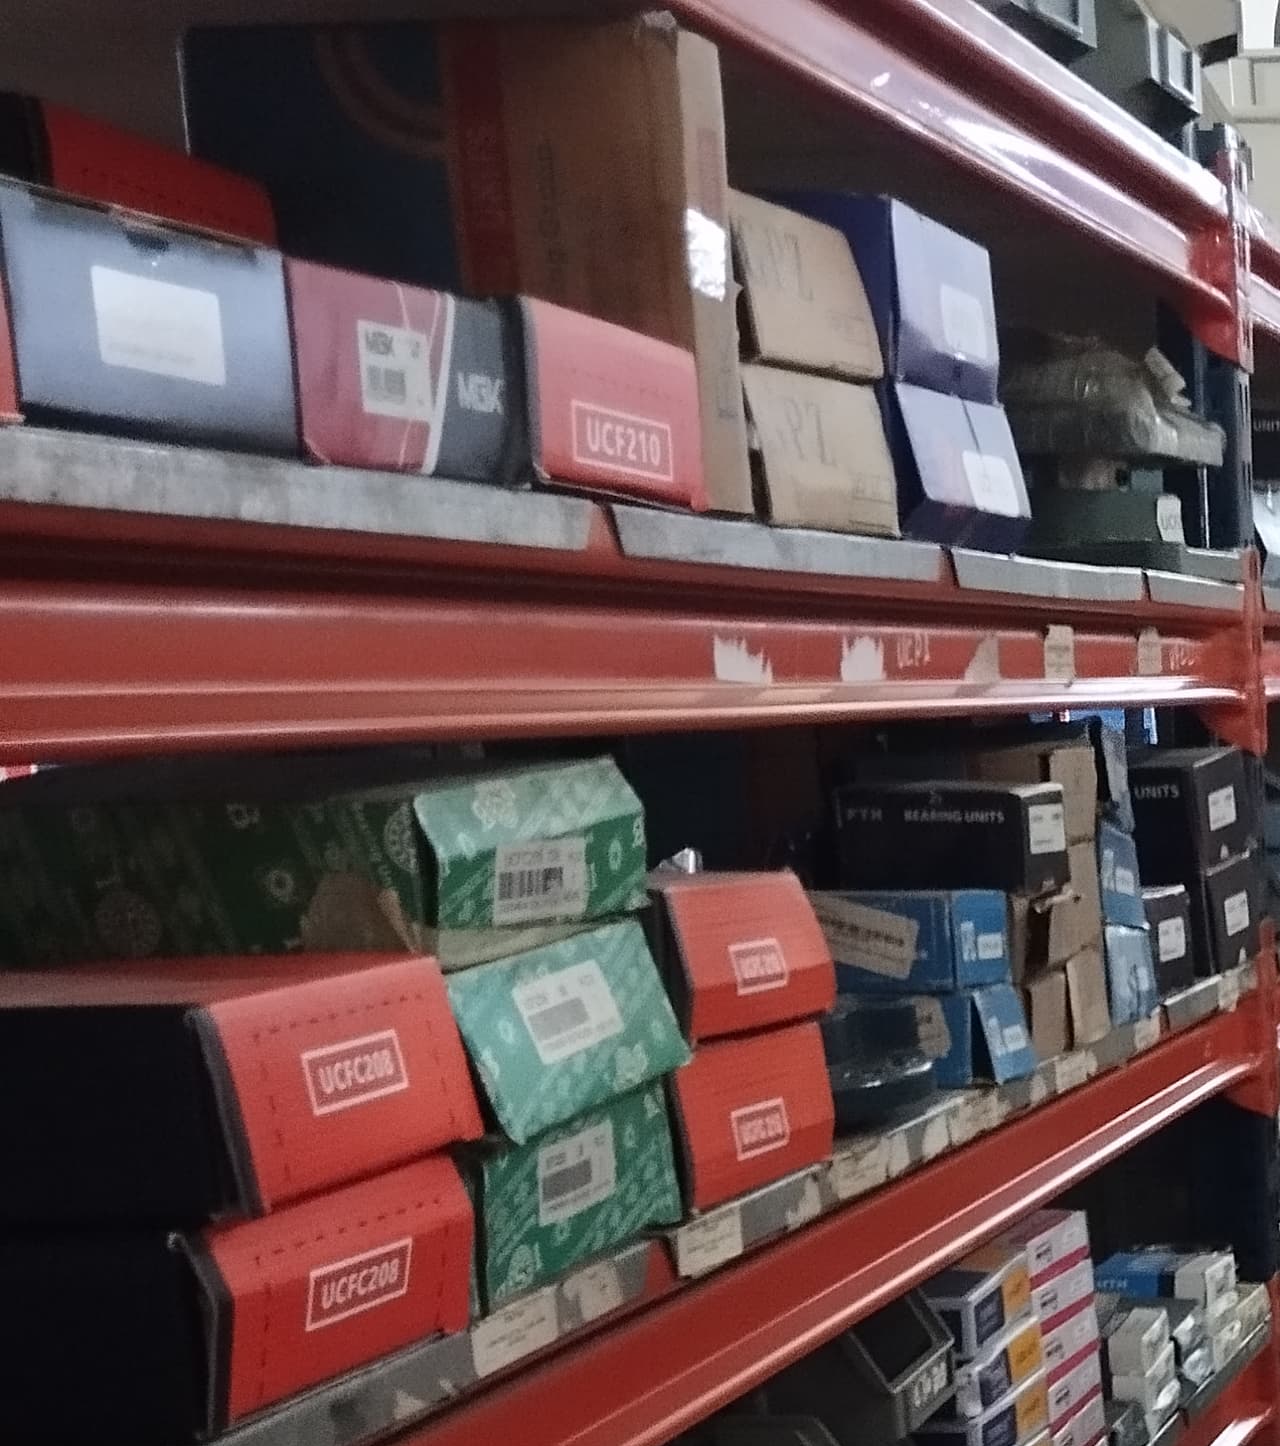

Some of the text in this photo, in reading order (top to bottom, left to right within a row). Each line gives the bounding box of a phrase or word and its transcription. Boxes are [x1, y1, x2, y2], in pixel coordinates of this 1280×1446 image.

[585, 416, 662, 467] UCF210
[903, 808, 962, 824] BEARING
[964, 809, 1006, 825] UNITS
[318, 1048, 395, 1096] UCFC208
[320, 1257, 401, 1311] UCFC208
